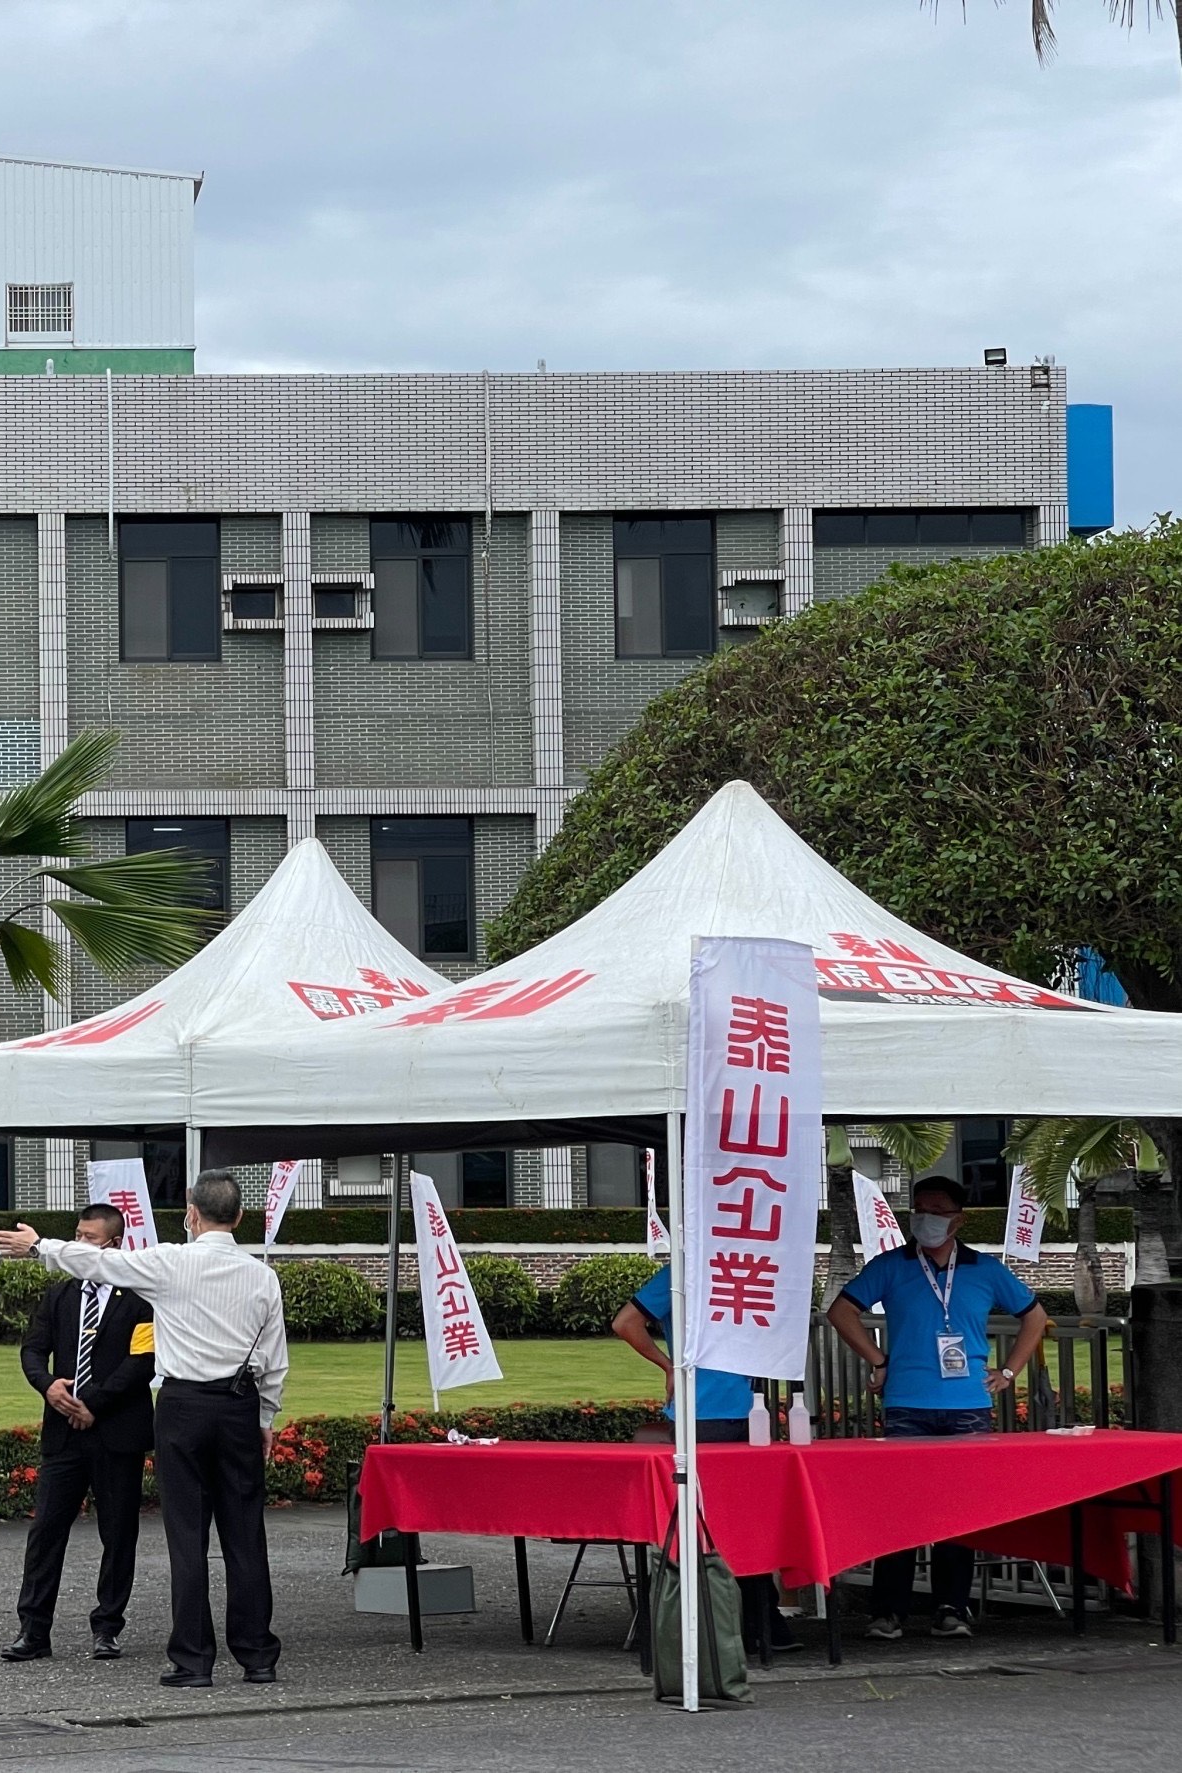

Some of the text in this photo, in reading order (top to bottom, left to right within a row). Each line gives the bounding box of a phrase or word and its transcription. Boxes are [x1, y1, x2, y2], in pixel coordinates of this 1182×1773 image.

[828, 932, 930, 966] 泰山
[357, 967, 431, 998] 泰山
[372, 968, 597, 1030] 泰山
[878, 965, 1042, 1002] BUFF
[709, 995, 791, 1328] 泰山企業
[426, 1201, 480, 1361] 泰山企業
